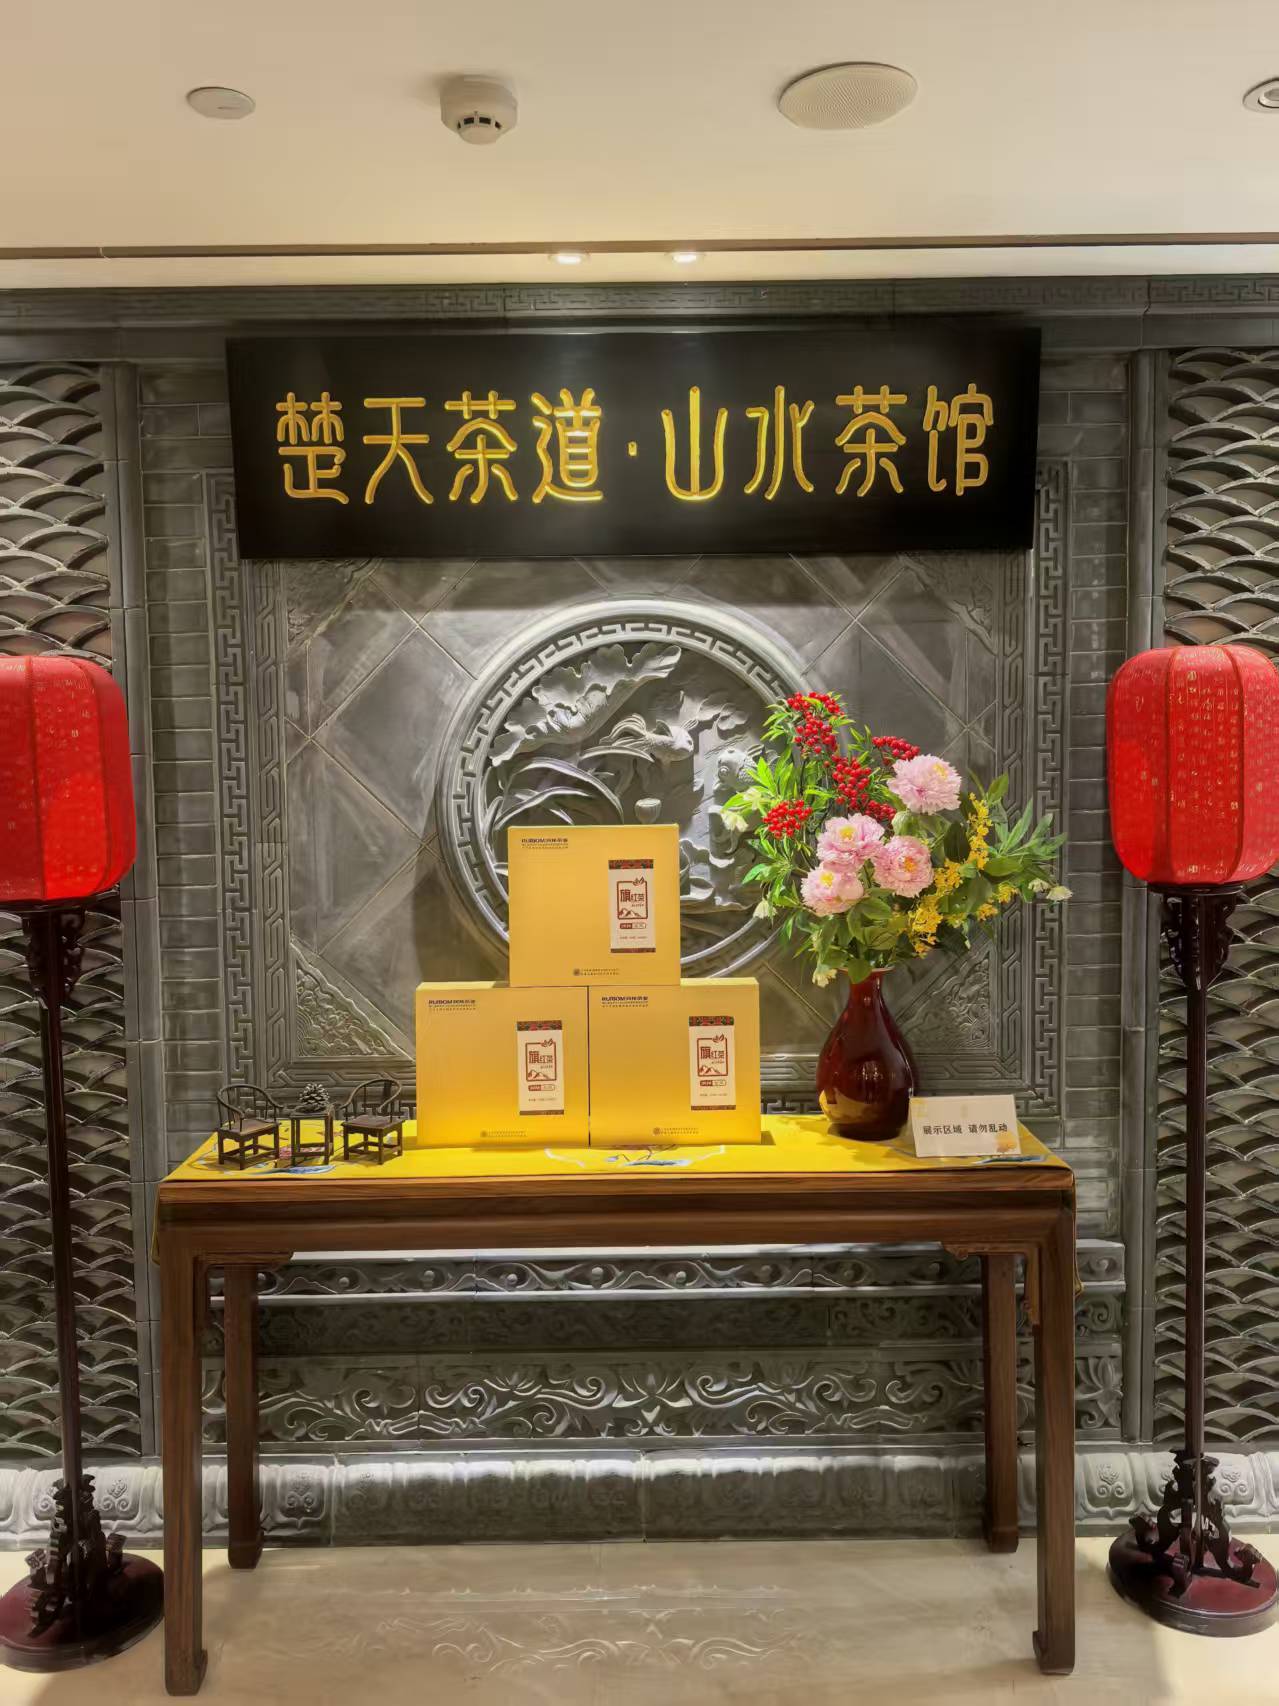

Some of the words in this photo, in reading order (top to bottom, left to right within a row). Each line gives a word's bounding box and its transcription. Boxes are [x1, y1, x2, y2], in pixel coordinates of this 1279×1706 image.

[923, 1124, 962, 1135] 展示区域
[968, 1122, 1008, 1134] 请勿乱动
